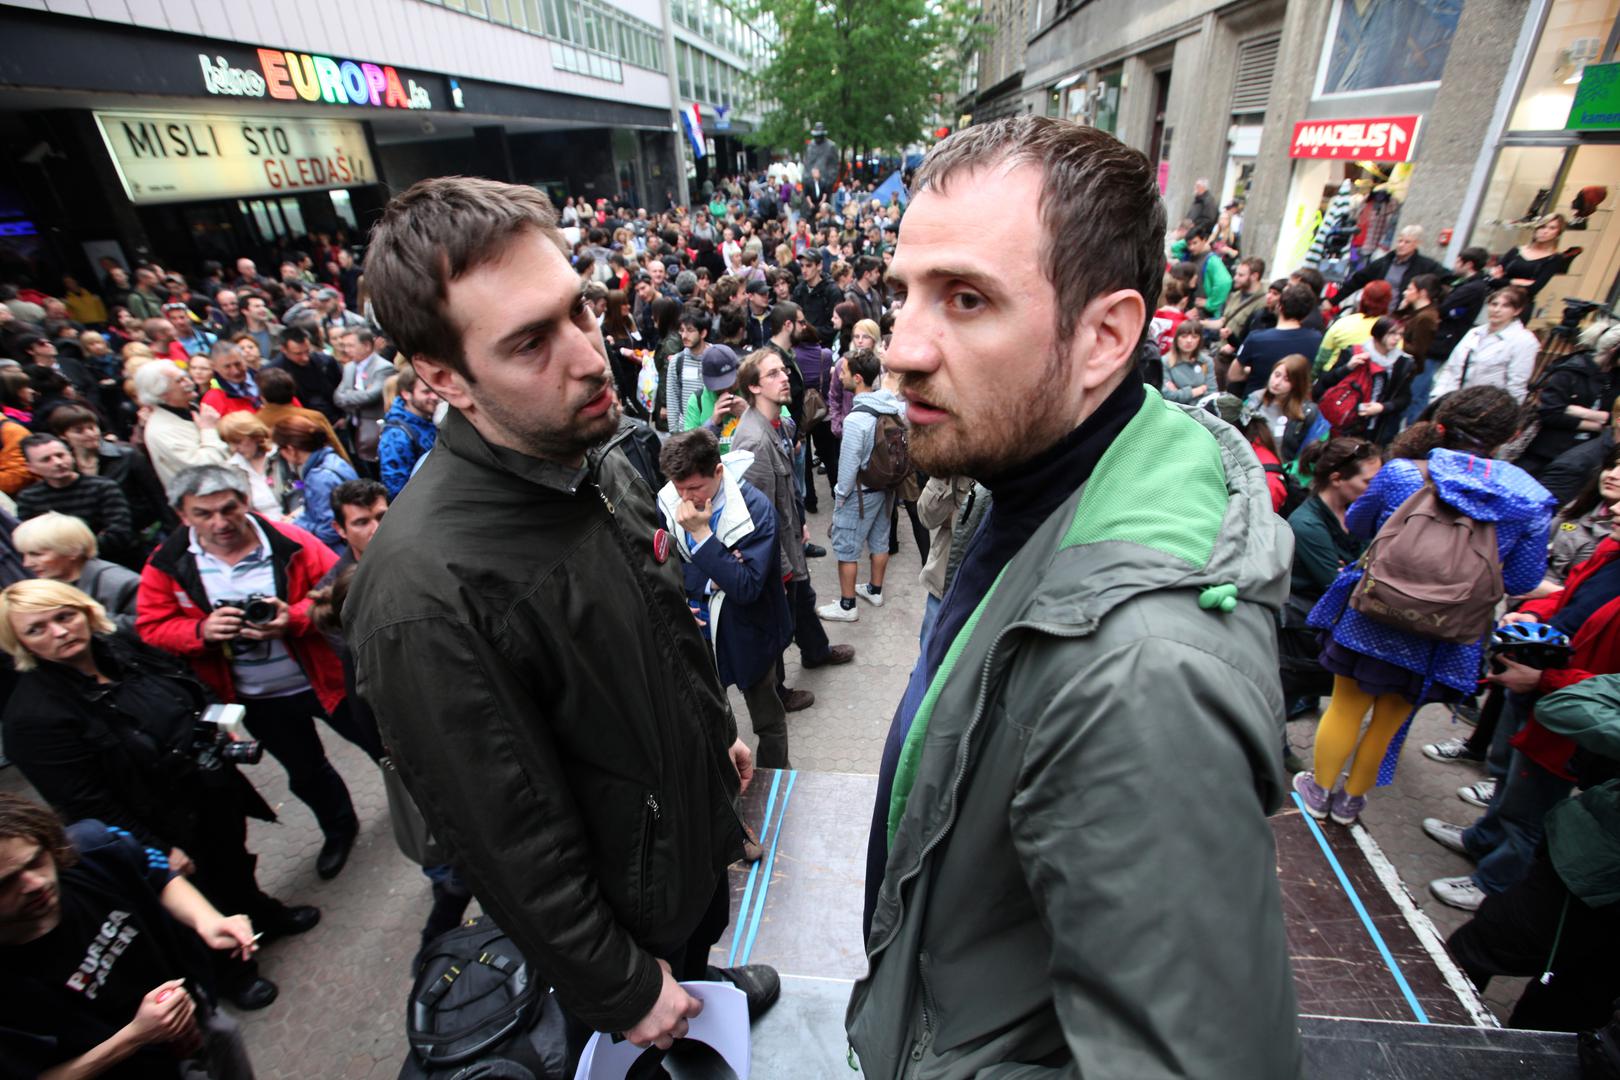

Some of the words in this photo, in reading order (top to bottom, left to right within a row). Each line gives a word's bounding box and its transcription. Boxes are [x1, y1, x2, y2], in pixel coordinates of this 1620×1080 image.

[198, 53, 265, 97] kino
[121, 120, 222, 158] MISLI
[1295, 122, 1392, 148] AMADEUS
